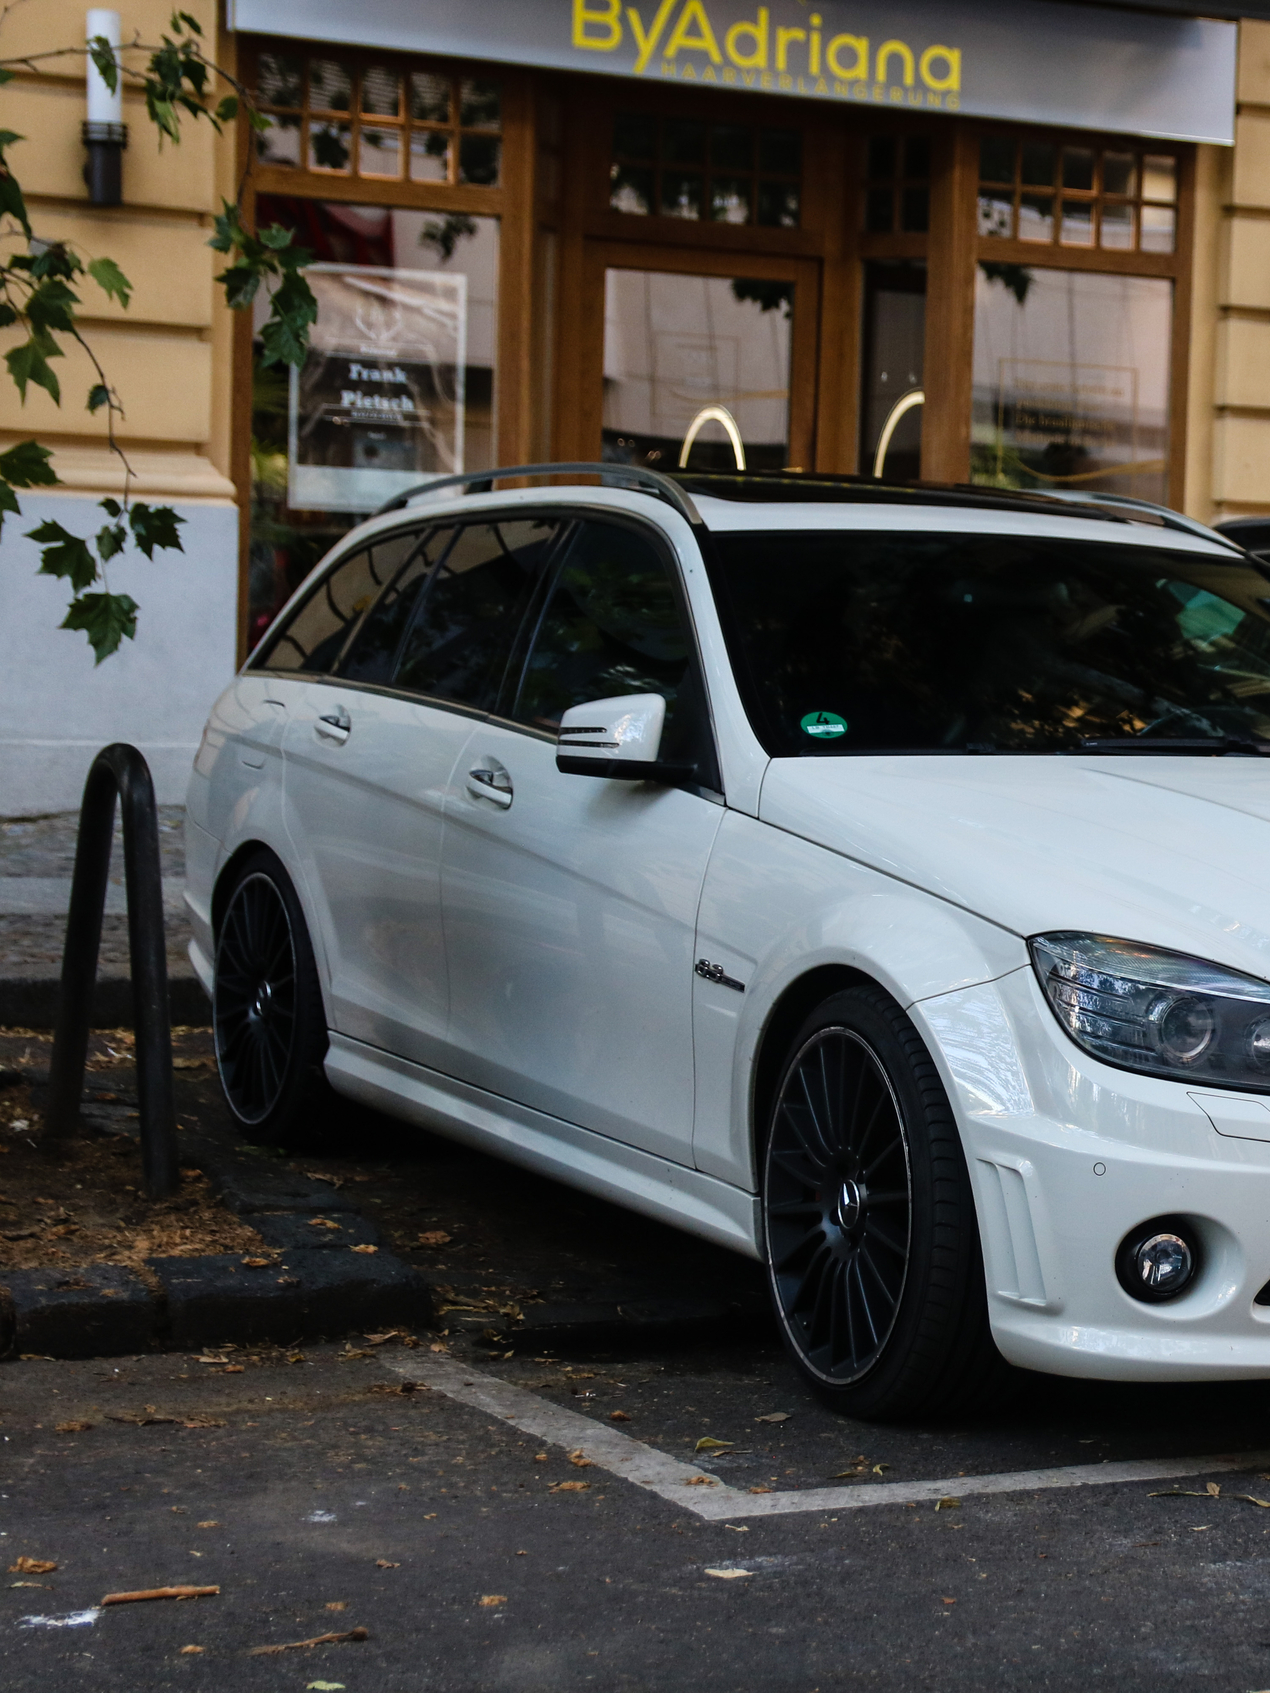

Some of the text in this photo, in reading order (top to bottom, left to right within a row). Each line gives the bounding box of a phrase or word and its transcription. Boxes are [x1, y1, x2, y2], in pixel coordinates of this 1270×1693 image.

[349, 362, 407, 384] Frank
[341, 390, 414, 411] Pietsch
[816, 712, 830, 725] 4
